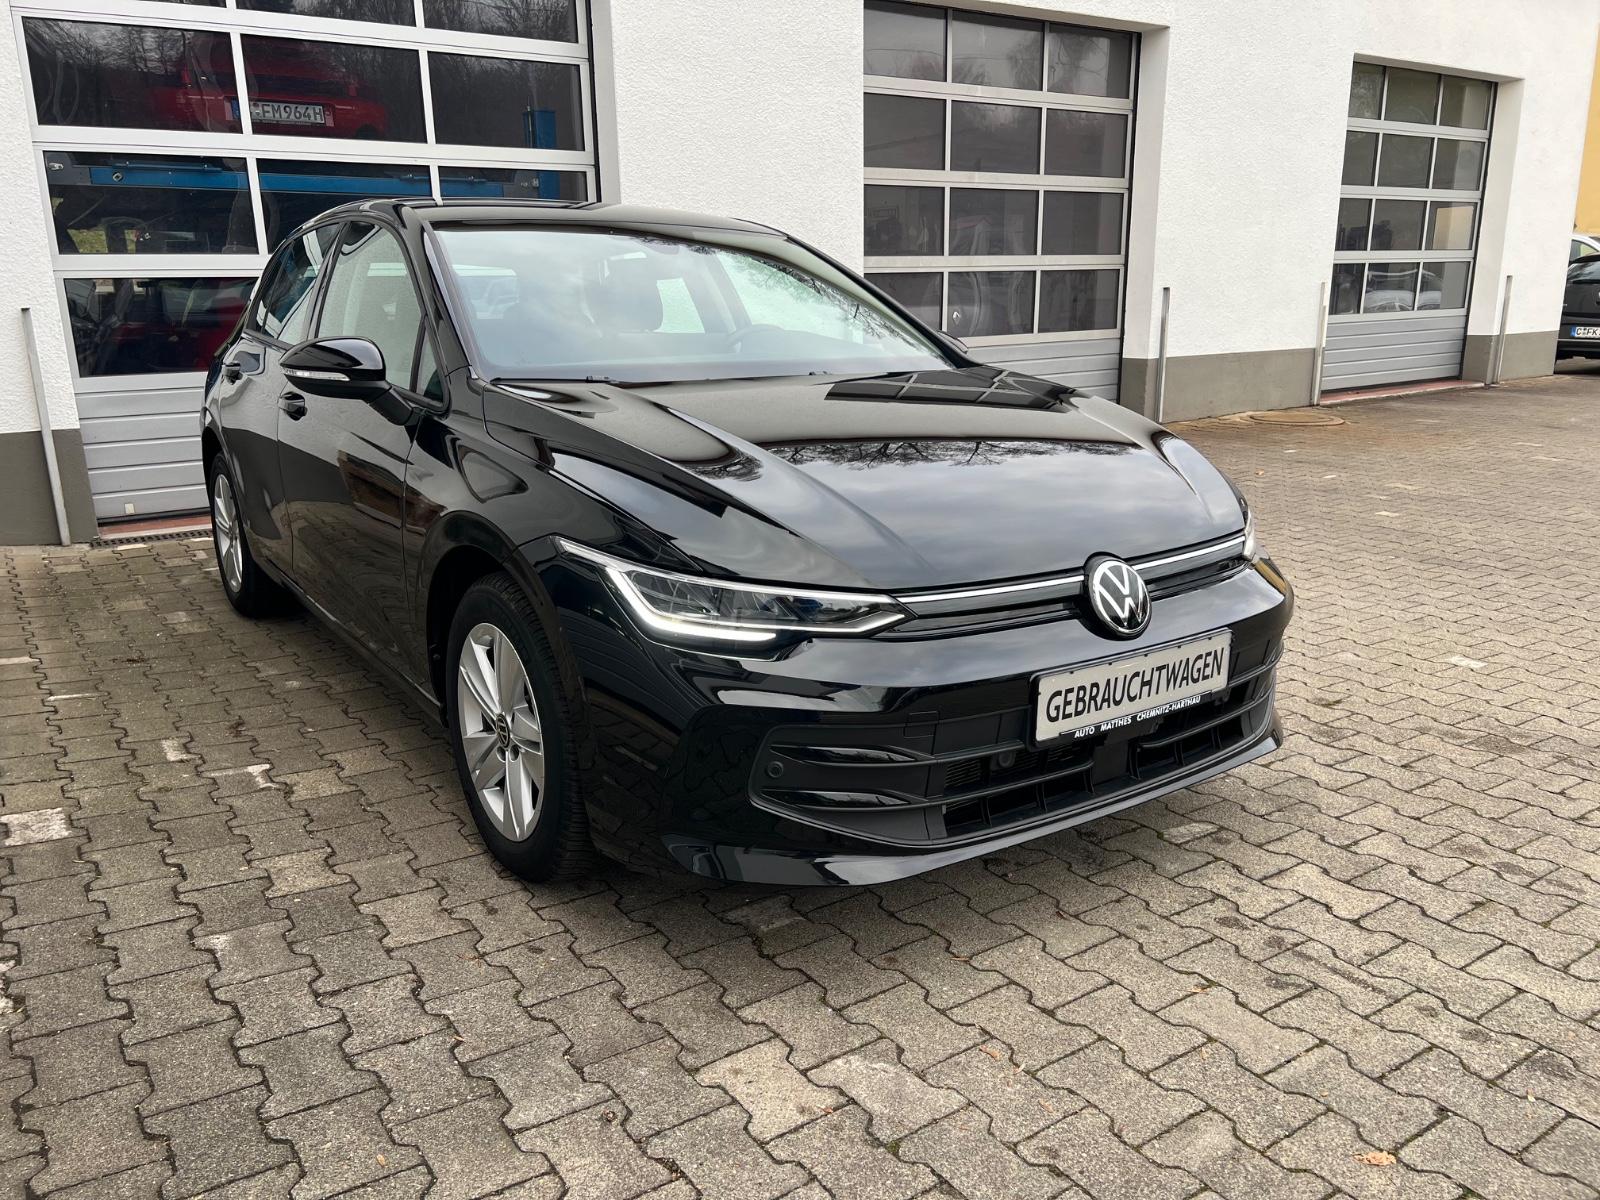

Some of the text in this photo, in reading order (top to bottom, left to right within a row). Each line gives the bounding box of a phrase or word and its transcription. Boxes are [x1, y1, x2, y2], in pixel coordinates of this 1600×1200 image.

[1046, 647, 1225, 723] GEBRAUCHTWAGEN
[1074, 695, 1201, 739] AUTO MATTHES CHEMNITZ-HARTHAU
